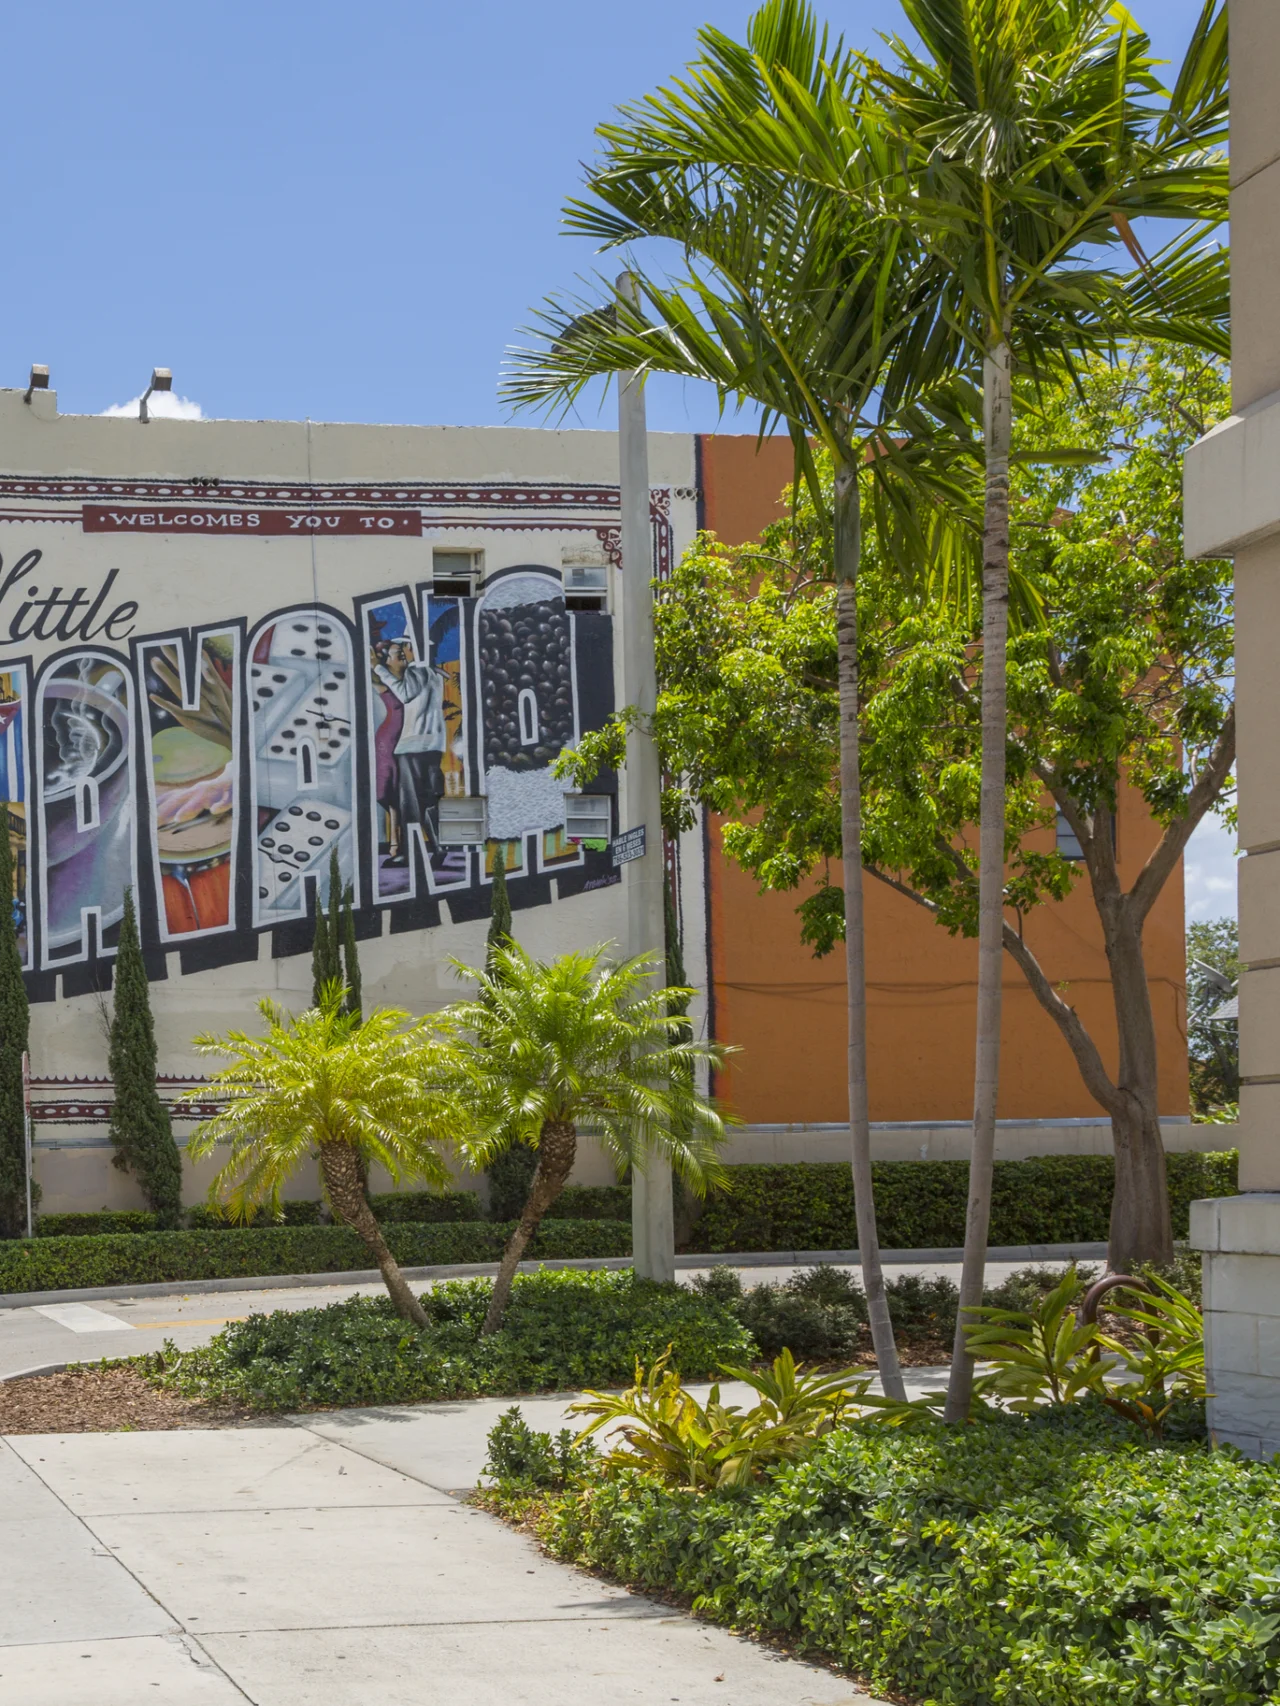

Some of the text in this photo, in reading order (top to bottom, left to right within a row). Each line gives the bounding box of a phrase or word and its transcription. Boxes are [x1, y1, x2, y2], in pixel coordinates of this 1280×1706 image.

[109, 512, 396, 530] WELCOMES YOU TO
